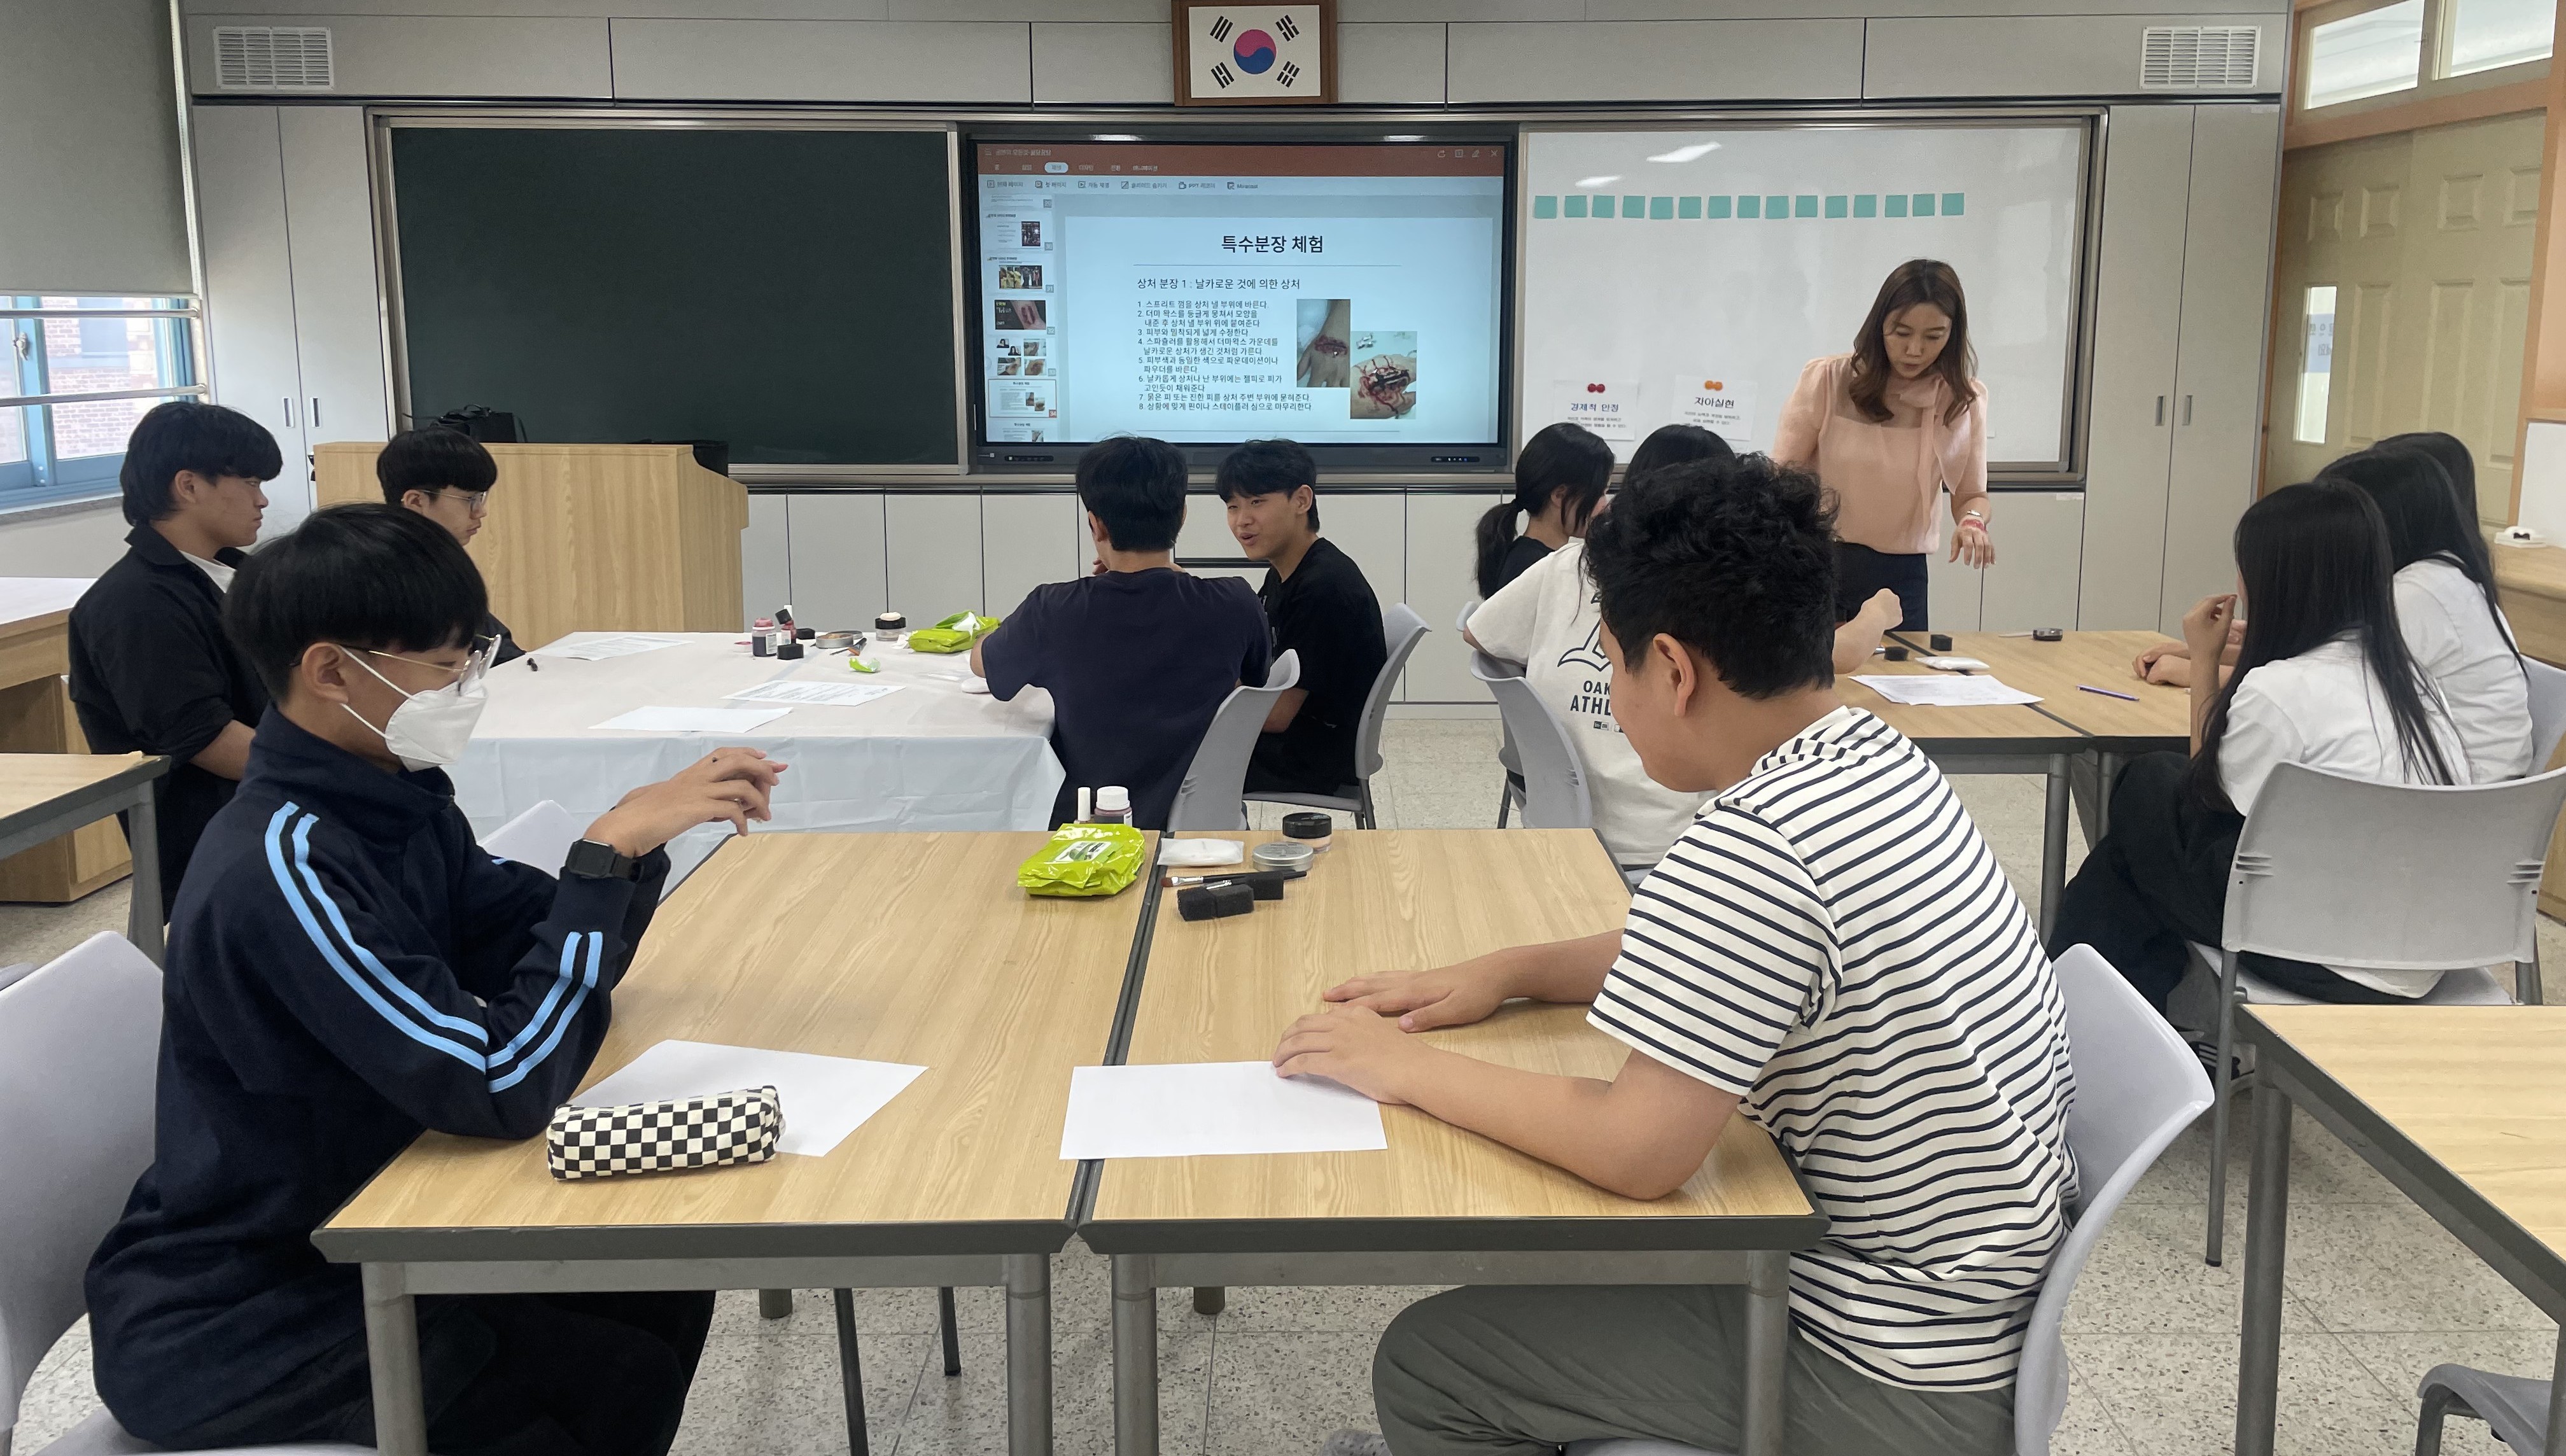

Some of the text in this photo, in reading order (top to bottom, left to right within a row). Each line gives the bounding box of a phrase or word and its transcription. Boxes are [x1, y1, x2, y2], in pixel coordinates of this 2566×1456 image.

[1221, 235, 1323, 253] 특수분장 체험
[1137, 278, 1156, 290] 상처
[1160, 279, 1179, 290] 분장
[1181, 279, 1186, 288] 1
[1195, 278, 1233, 290] 날카로운
[1237, 279, 1256, 290] 것에
[1259, 279, 1278, 290] 의한
[1281, 279, 1300, 290] 상처
[1146, 300, 1175, 309] 스프리트
[1195, 300, 1209, 309] 상처
[1221, 300, 1243, 309] 부위에
[1235, 309, 1258, 319] 모양을
[1171, 319, 1186, 328] 상처
[1197, 319, 1212, 328] 부위
[1214, 319, 1228, 328] 위에
[1146, 328, 1168, 337] 피부와
[1186, 337, 1215, 346] 활용해서
[1249, 338, 1278, 347] 가운데를
[1144, 347, 1173, 356] 날카로운
[1175, 347, 1197, 356] 상처가
[1200, 347, 1214, 356] 생긴
[1216, 347, 1238, 356] 것처럼
[1147, 356, 1176, 365] 피부색과
[1179, 356, 1200, 365] 동일한
[1202, 356, 1224, 365] 색으로
[1226, 356, 1279, 365] 파운데이션이나
[1144, 365, 1173, 374] 파우더를
[1202, 375, 1210, 383] 난
[1212, 375, 1241, 383] 부위에는
[1268, 375, 1282, 383] 피가
[1144, 384, 1205, 393] 고인듯이 채워준다
[1164, 393, 1171, 402] 피
[1173, 393, 1188, 402] 또는
[1189, 393, 1204, 402] 진한
[1206, 393, 1221, 402] 피를
[1223, 393, 1237, 402] 상처
[1239, 393, 1254, 402] 주변
[1256, 393, 1278, 402] 부위에
[1147, 402, 1170, 411] 상황에
[1188, 402, 1210, 411] 핀이나
[1212, 402, 1248, 411] 스테이플러
[1251, 402, 1273, 411] 심으로
[1571, 403, 1597, 412] 경제적
[1695, 397, 1734, 409] 자아실현
[1570, 695, 1611, 716] ATHL
